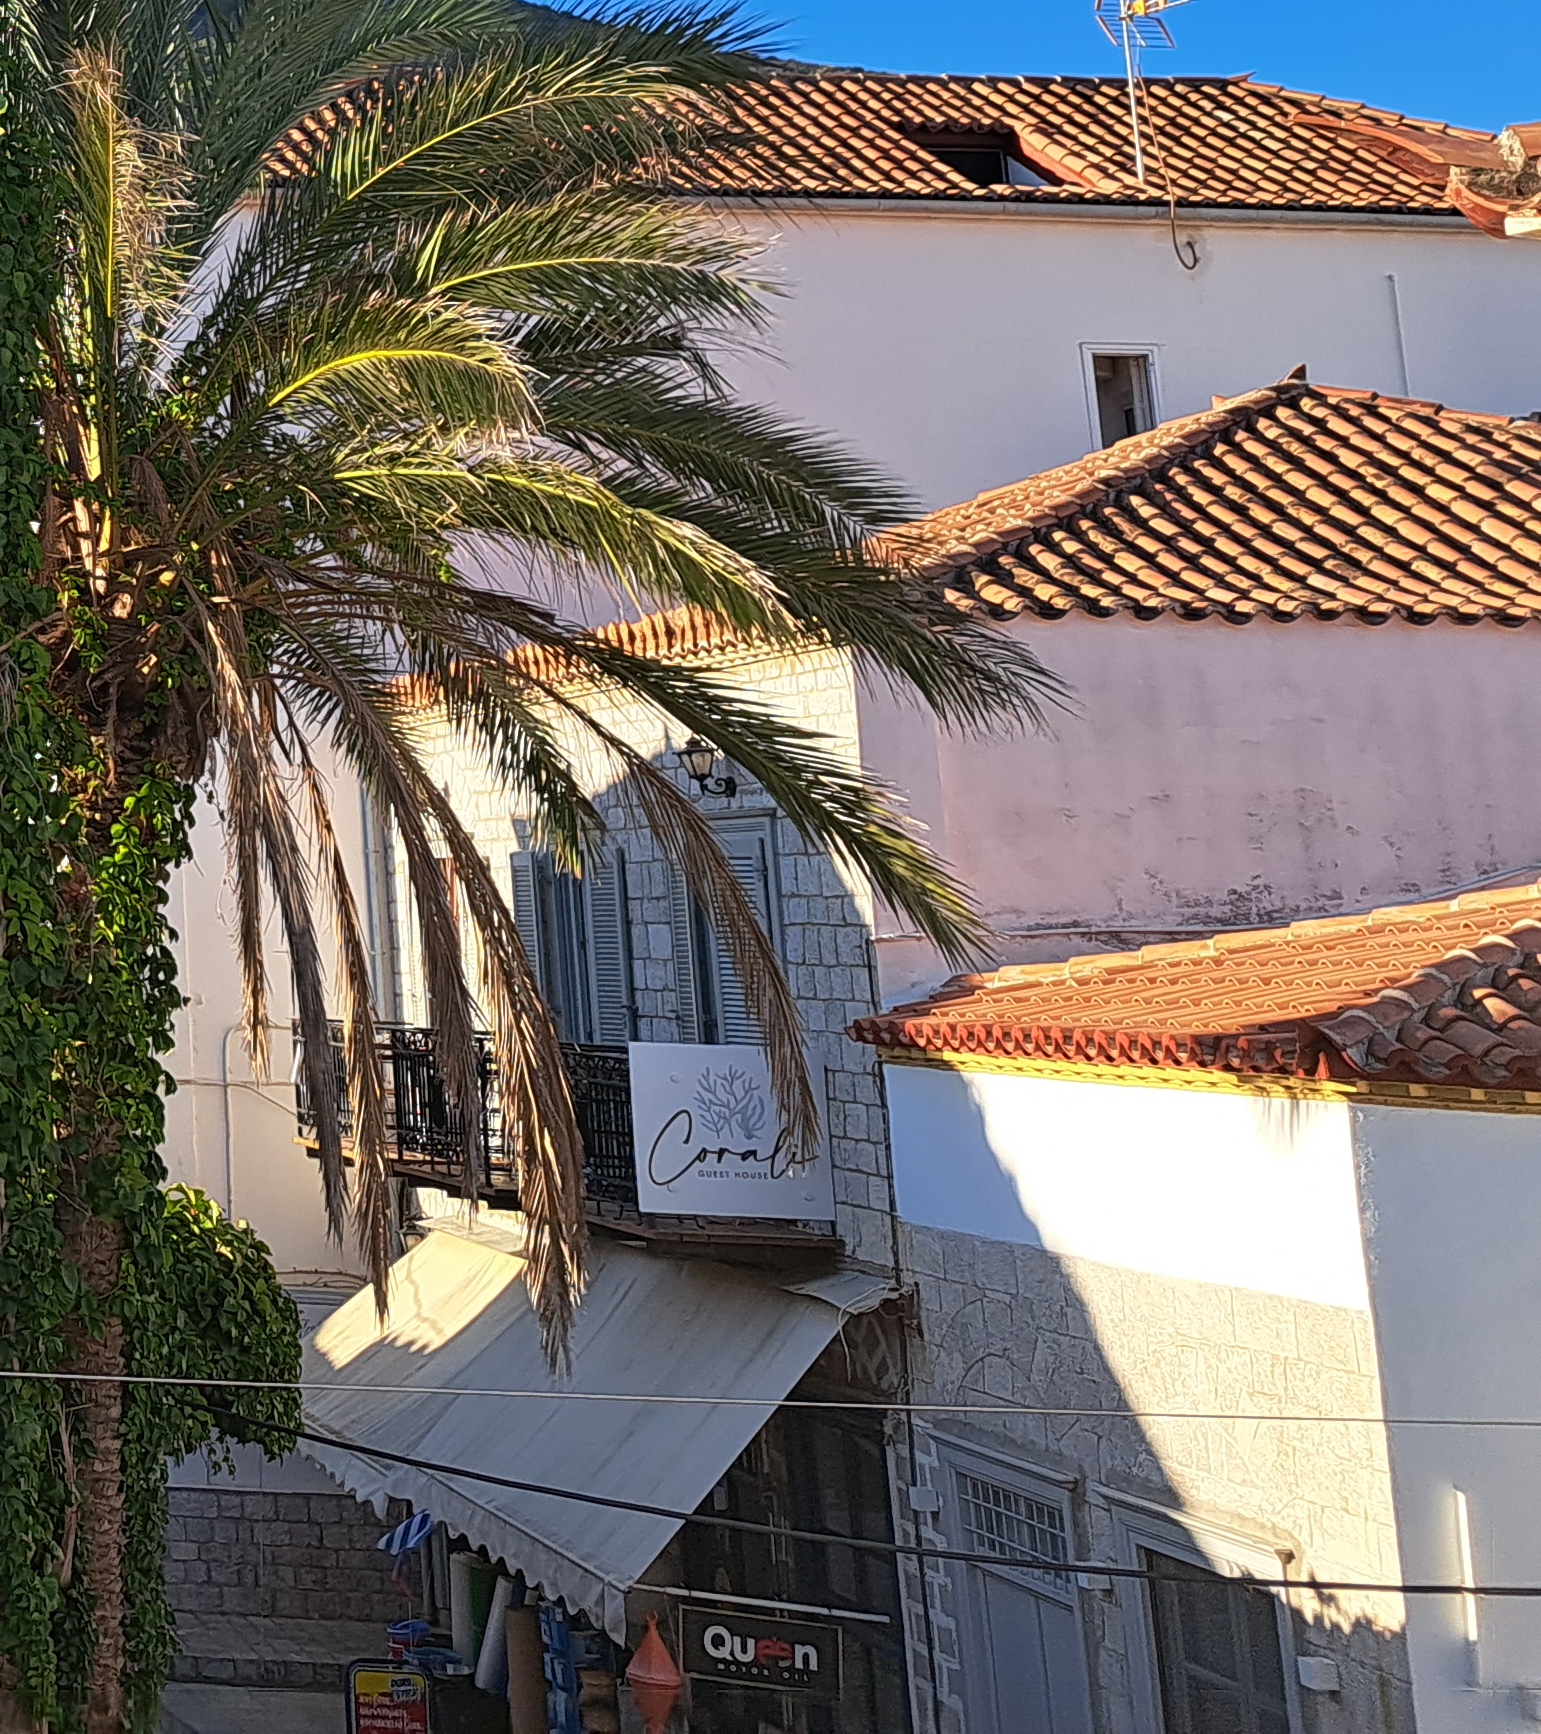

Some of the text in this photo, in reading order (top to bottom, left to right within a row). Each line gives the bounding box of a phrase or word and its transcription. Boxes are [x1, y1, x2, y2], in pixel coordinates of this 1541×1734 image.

[697, 1169, 769, 1180] GUEST HOUSE
[703, 1625, 818, 1672] Queen
[717, 1662, 810, 1682] MOTOR OIL
